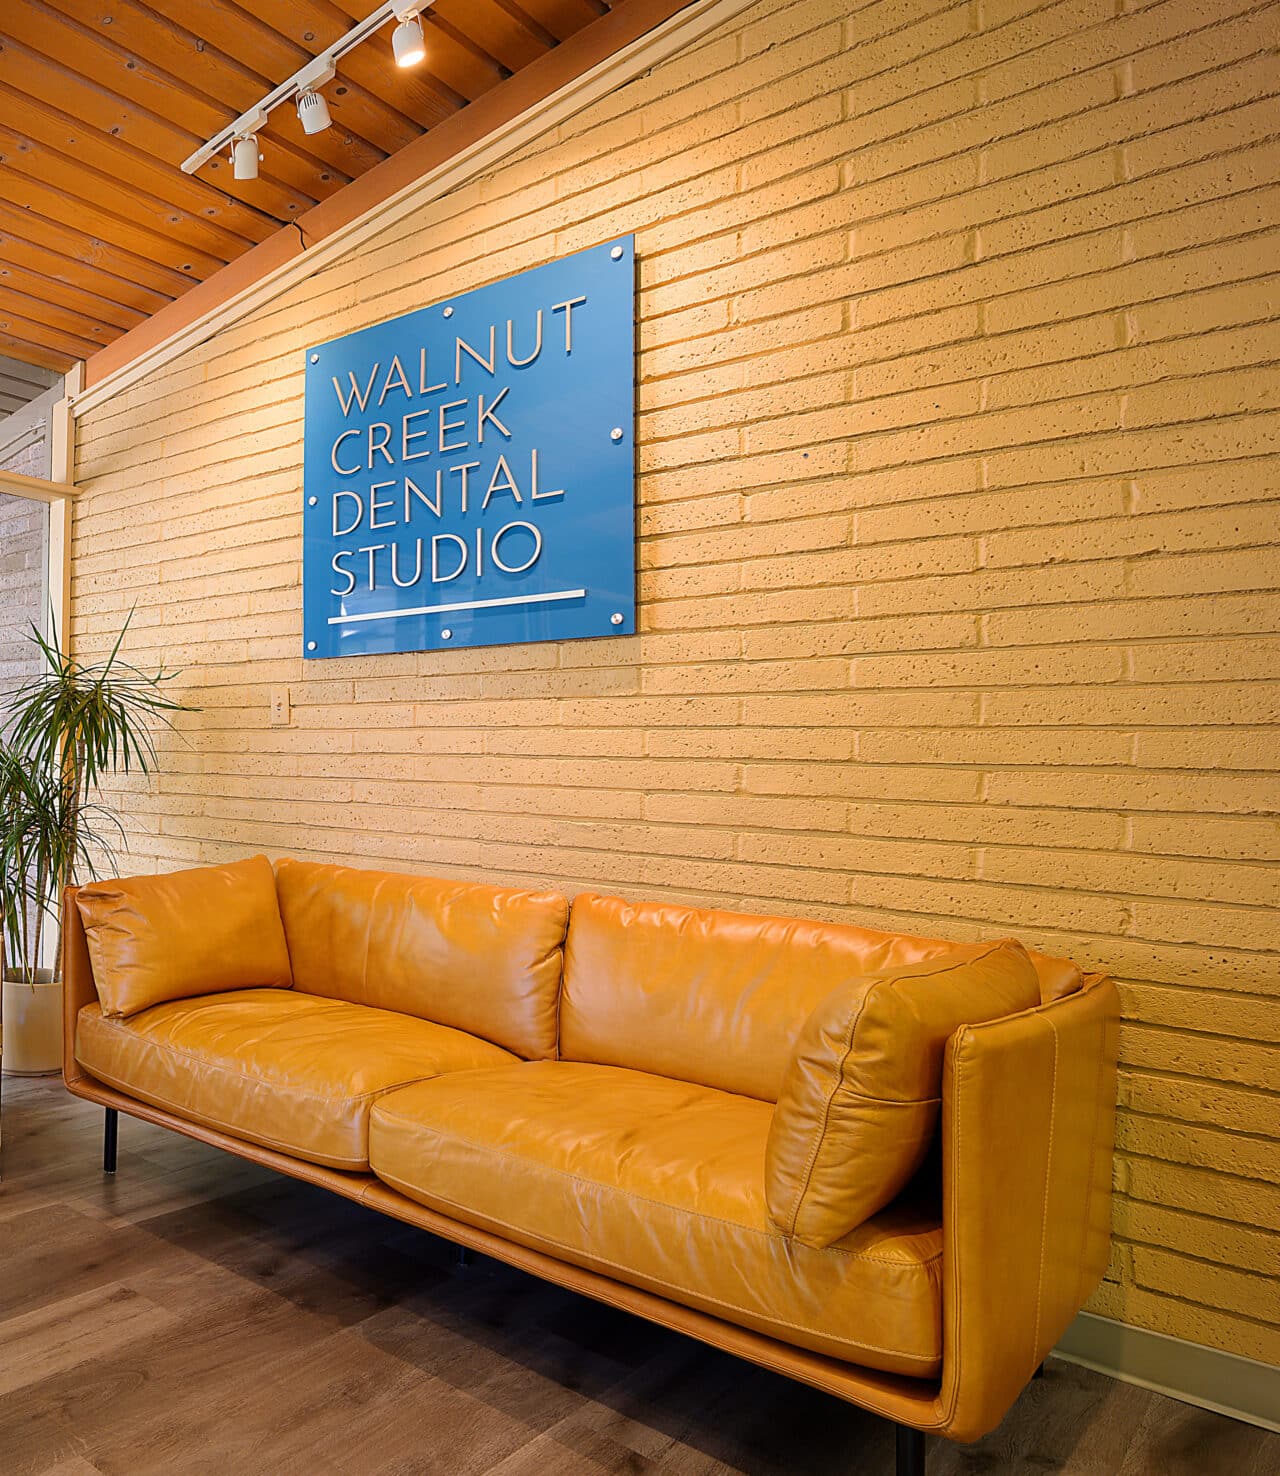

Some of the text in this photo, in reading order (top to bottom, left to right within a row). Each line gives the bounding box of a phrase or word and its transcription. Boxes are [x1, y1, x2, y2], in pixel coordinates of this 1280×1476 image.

[332, 296, 586, 417] WALNUT
[331, 387, 511, 475] CREEK
[332, 449, 564, 536] DENTAL
[330, 521, 542, 595] STUDIO
